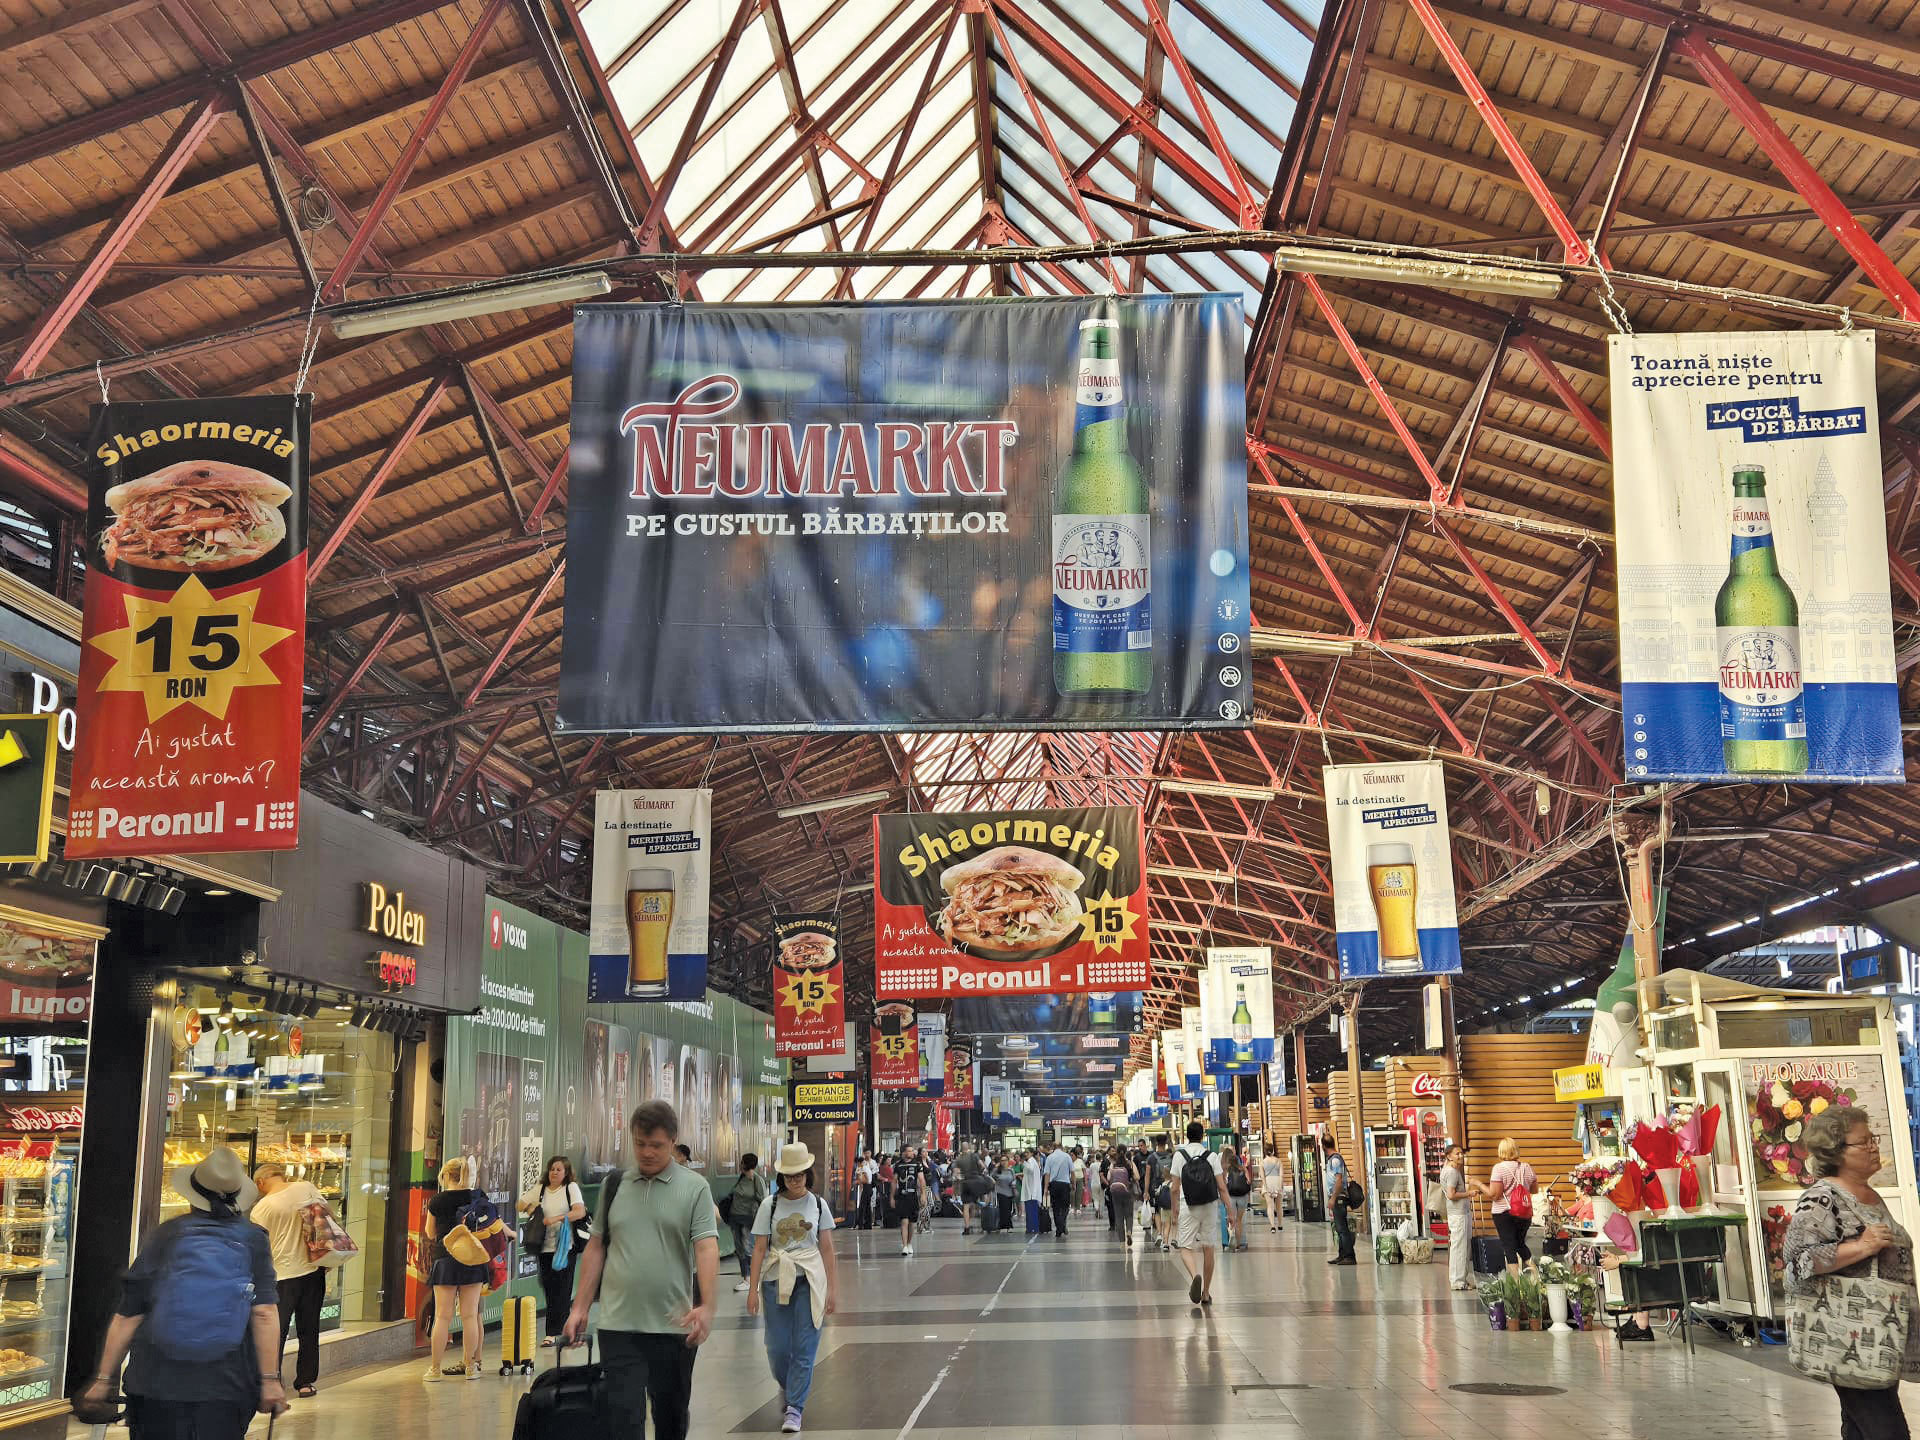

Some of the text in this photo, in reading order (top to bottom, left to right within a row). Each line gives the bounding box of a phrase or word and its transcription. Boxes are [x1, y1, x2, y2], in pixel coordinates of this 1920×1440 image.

[1631, 352, 1773, 371] Toarnă niște
[1078, 367, 1121, 388] NEUMARK
[1632, 370, 1823, 392] apreciere pentru
[1712, 403, 1792, 424] LOGICA
[1751, 412, 1861, 436] DE BĂRBAT
[97, 420, 296, 467] Shaormeria
[619, 372, 1018, 499] NEUMARKT
[625, 504, 1010, 542] PE GUSTUL BĂRBAȚILOR
[1732, 505, 1770, 522] NEUMARK
[1055, 554, 1148, 591] NEUMARKT
[135, 614, 241, 674] 15
[1719, 659, 1801, 690] NEUMARKT
[166, 676, 208, 700] RON
[134, 723, 237, 759] Ai gustat
[90, 759, 276, 791] această aromă?
[1362, 770, 1405, 785] NEUMARKT
[632, 795, 675, 810] NEUMARKT
[1336, 797, 1349, 806] La
[97, 801, 225, 839] Peronul
[604, 821, 618, 830] La
[1383, 814, 1435, 828] APRECIERE
[647, 841, 699, 853] APRECIERE
[898, 819, 1120, 878] Shaormeria
[367, 881, 425, 946] Polen
[1089, 906, 1124, 933] 15
[503, 922, 527, 950] voxa
[774, 919, 837, 936] Shaormeria
[883, 921, 931, 941] Ai gustat
[882, 941, 969, 958] această aromă?
[1099, 934, 1117, 944] RON
[942, 963, 1051, 990] Peronul
[792, 982, 824, 1001] 15
[785, 1039, 824, 1052] Peronul
[882, 1038, 905, 1050] 15
[1752, 1058, 1858, 1081] FLORĂRIE
[799, 1086, 850, 1096] EXCHANGE
[795, 1108, 855, 1119] 0% COMISION
